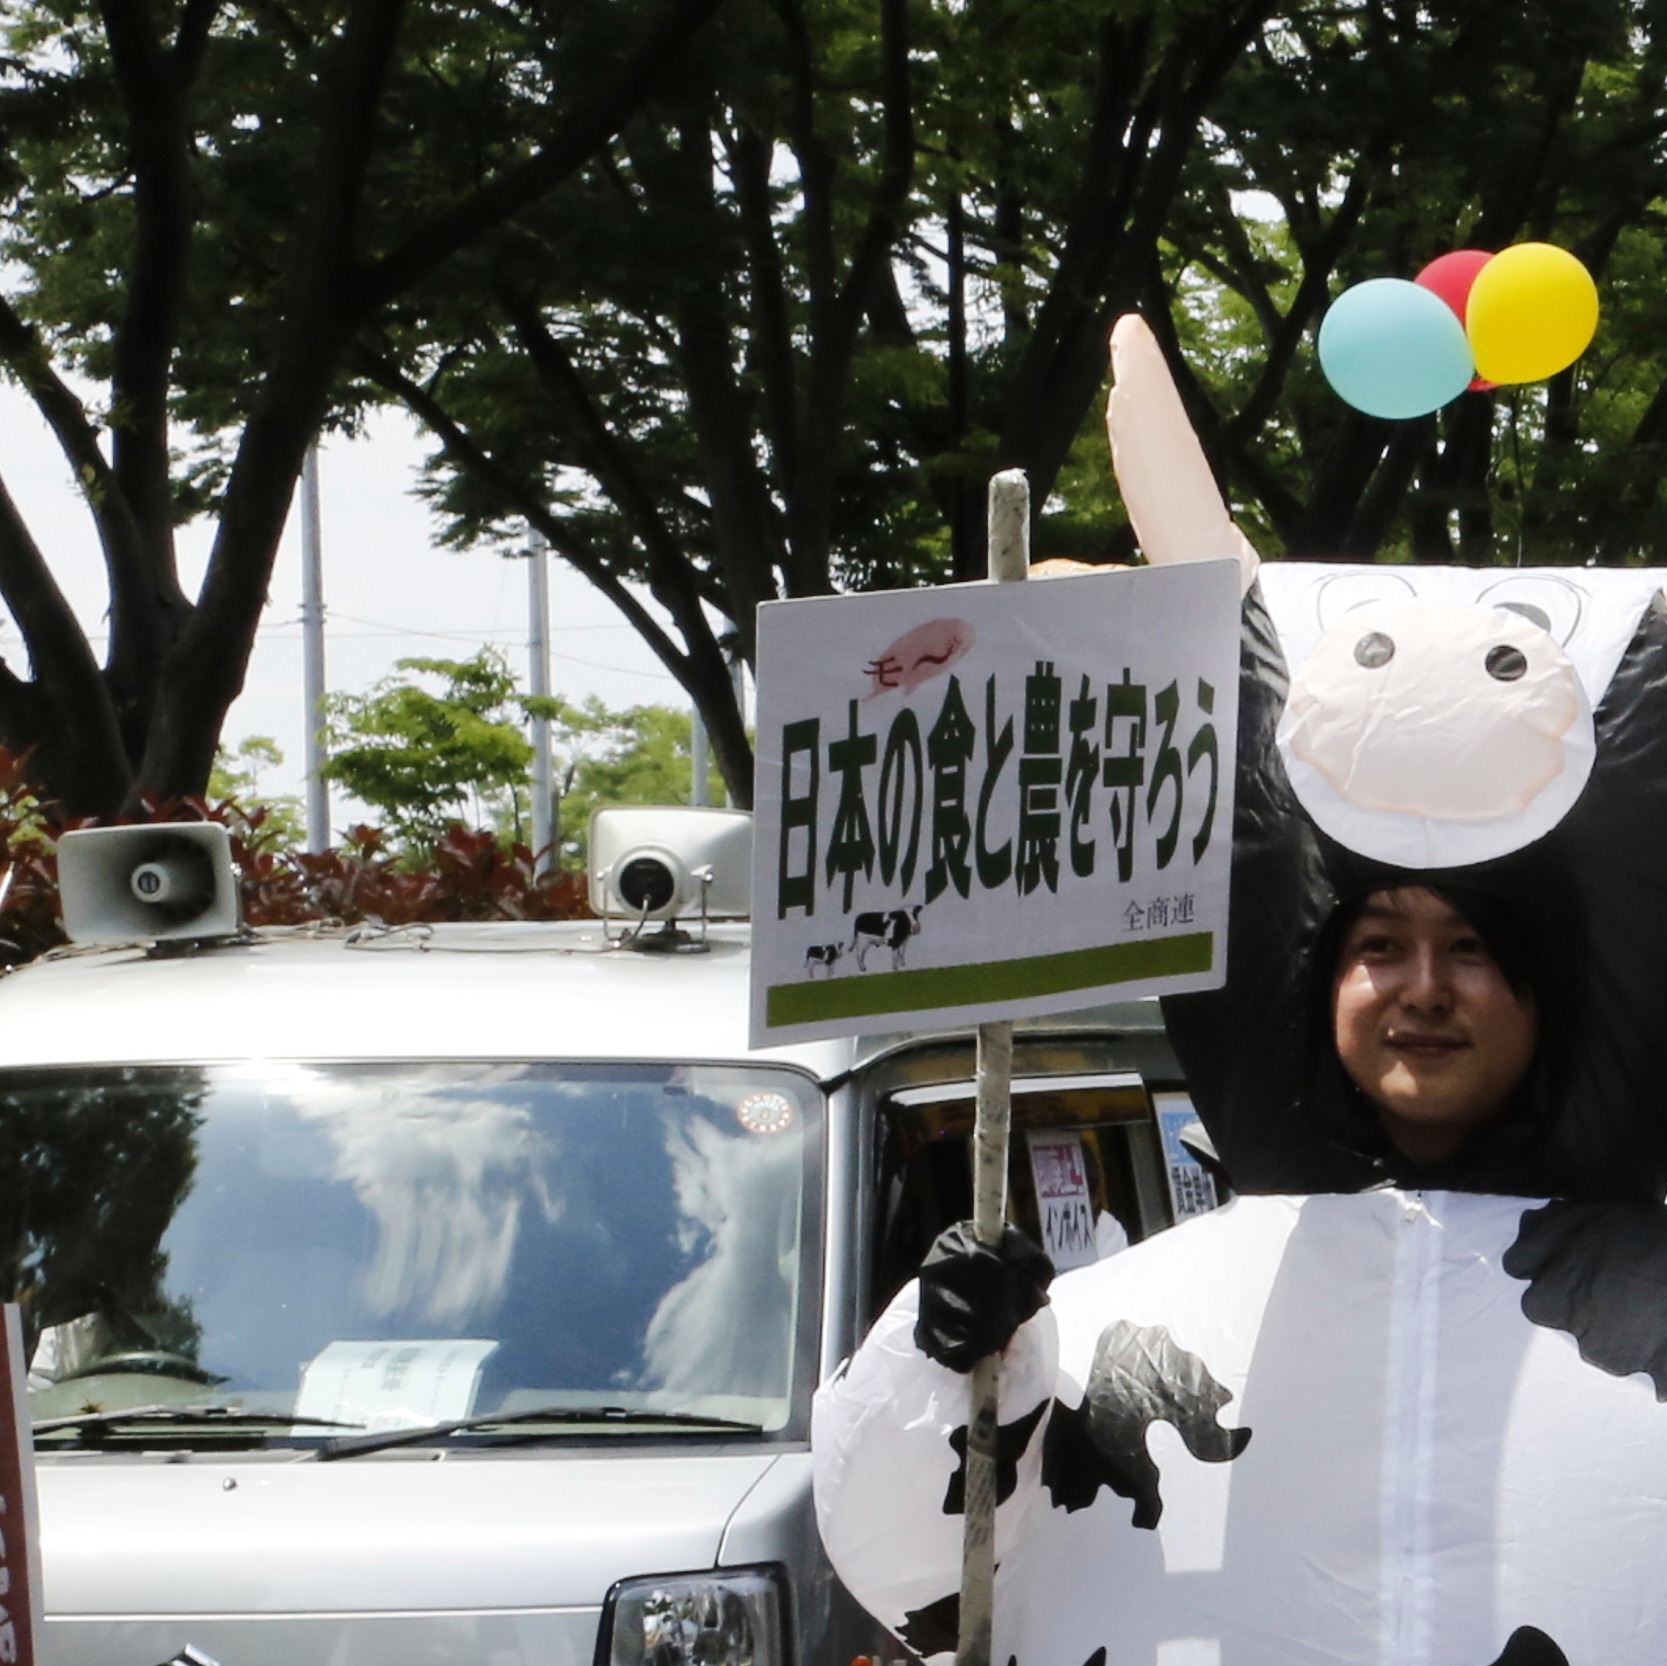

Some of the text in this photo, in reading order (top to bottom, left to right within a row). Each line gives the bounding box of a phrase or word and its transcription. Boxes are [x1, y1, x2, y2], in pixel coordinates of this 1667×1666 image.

[777, 660, 1219, 920] 日本の食と農を守ろう
[1121, 893, 1196, 933] 全商連
